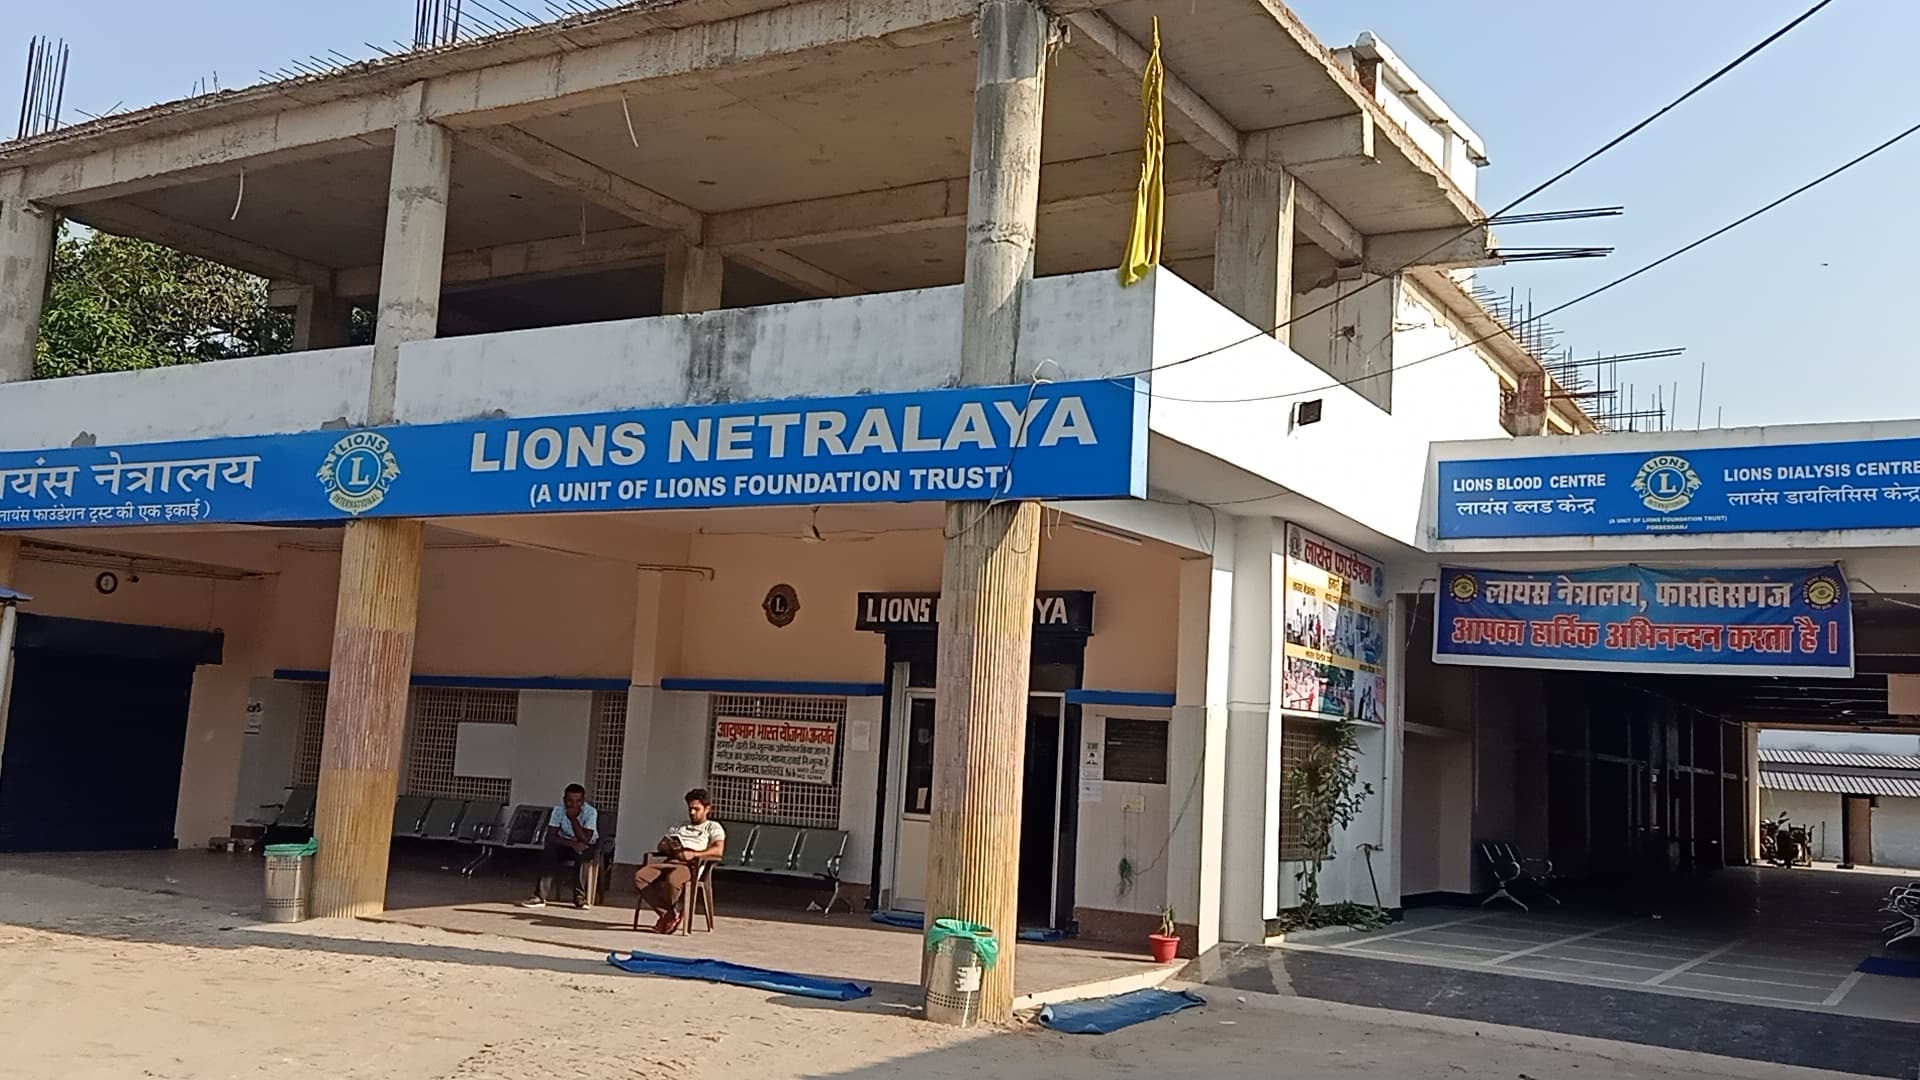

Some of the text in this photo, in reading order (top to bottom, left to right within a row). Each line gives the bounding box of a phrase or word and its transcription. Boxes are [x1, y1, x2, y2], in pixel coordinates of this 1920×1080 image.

[338, 434, 386, 452] LIONS
[470, 396, 1098, 472] LIONS NETRALAYA
[90, 451, 262, 496] नेत्रालय
[348, 456, 370, 486] L
[1647, 458, 1687, 470] LIONS
[1724, 460, 1920, 482] LIONS DIALYSIS CENTRE
[529, 464, 1013, 508] (A UNIT OF LIONS FOUNDATION TRUST)
[1453, 474, 1607, 492] LIONS BLOOD CENTRE
[1658, 473, 1678, 493] L
[1456, 494, 1597, 516] लायंस ब्लड केन्द्र
[1727, 488, 1779, 506] लायंस
[1784, 485, 1878, 504] डायलिसिस
[32, 503, 86, 522] फाउंडेशन
[116, 501, 135, 519] की
[138, 504, 162, 522] एक
[1305, 539, 1333, 573] लायंस
[1485, 575, 1552, 606] लायंस
[1556, 575, 1648, 613] नेत्रालय,
[866, 598, 931, 623] LIONS
[1452, 616, 1526, 645] आपका
[1530, 614, 1600, 647] हार्दिक
[1605, 616, 1723, 652] अभिनन्दन
[1727, 623, 1794, 653] करता
[758, 724, 780, 741] भारत
